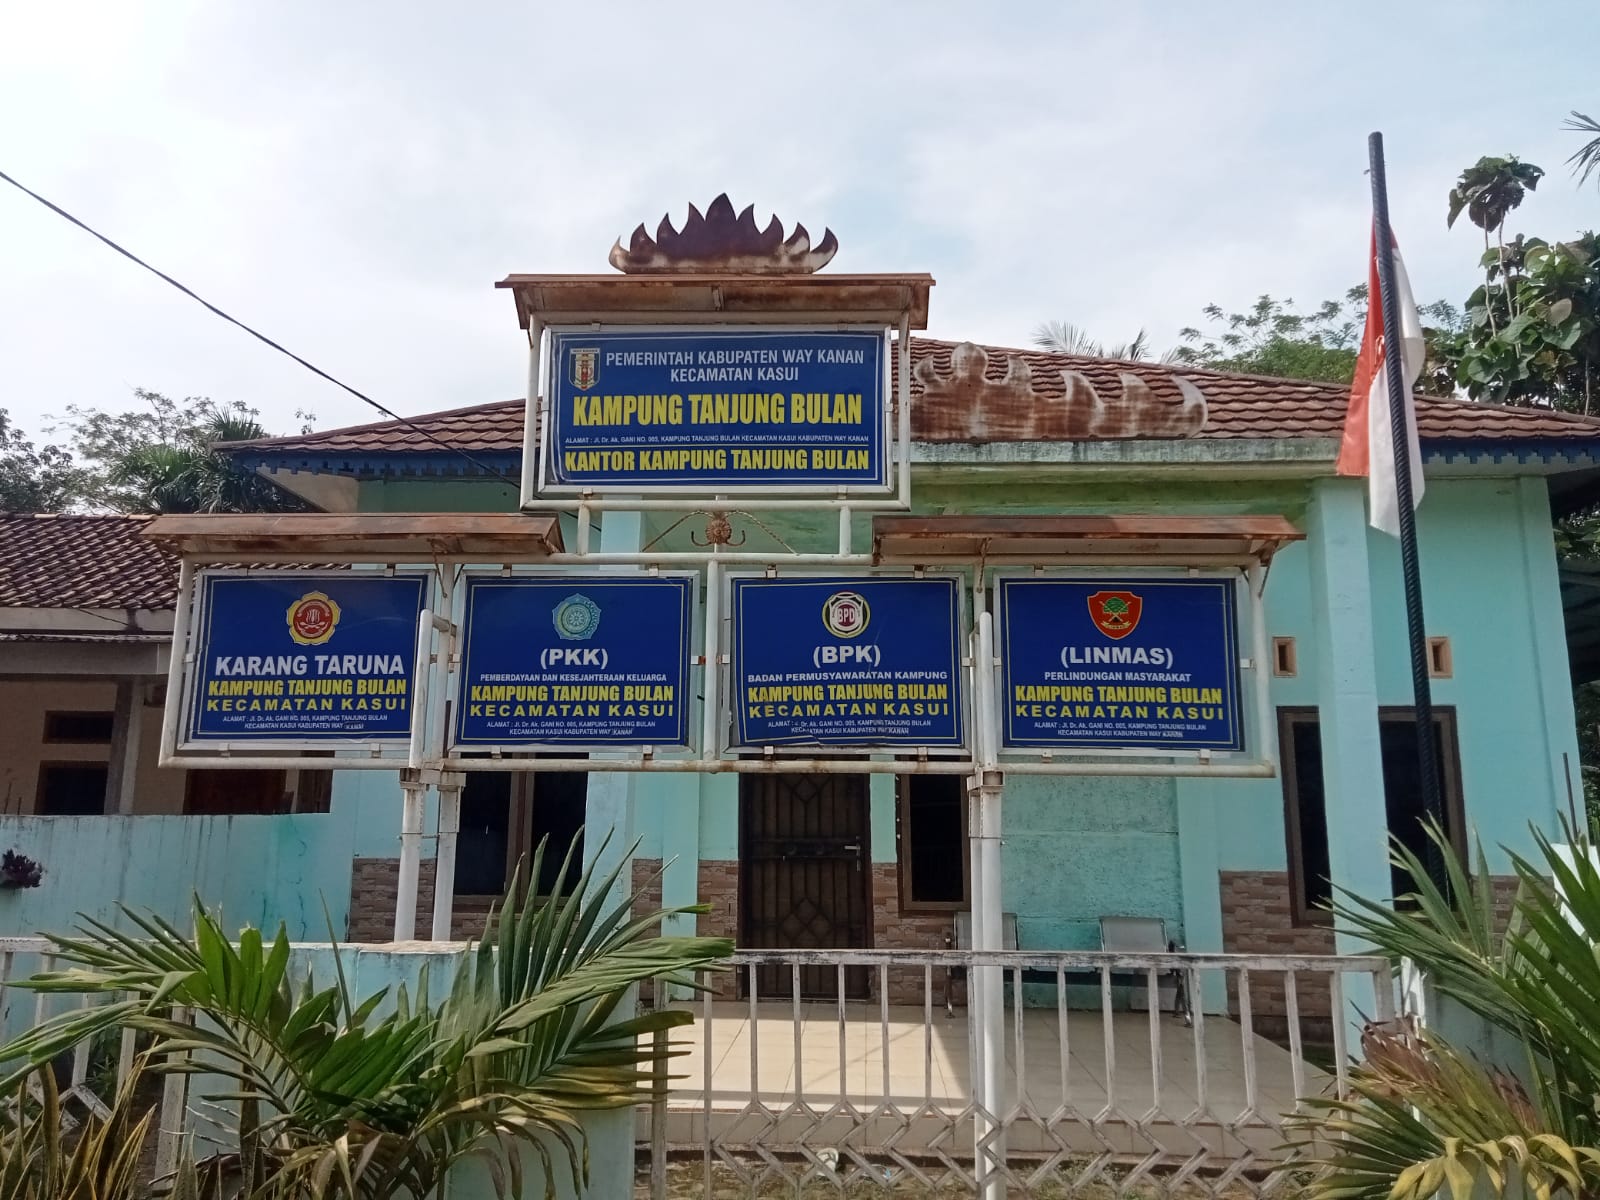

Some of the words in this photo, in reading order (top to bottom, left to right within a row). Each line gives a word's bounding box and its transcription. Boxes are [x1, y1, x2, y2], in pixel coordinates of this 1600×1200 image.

[605, 351, 694, 366] PEMERINTAH
[698, 350, 778, 365] KABUPATEN
[782, 349, 812, 364] WAY
[817, 349, 864, 364] KANAN
[670, 368, 752, 383] KECAMATAN
[757, 367, 799, 382] KASUI
[573, 394, 682, 426] KAMPUNG
[688, 393, 785, 425] TANJUNG
[791, 394, 862, 424] BULAN
[565, 451, 635, 472] KANTOR
[639, 449, 726, 470] KAMPUNG
[731, 449, 808, 470] TANJUNG
[812, 449, 869, 470] BULAN
[540, 648, 608, 670] (PKK)
[813, 645, 881, 668] (BPK)
[1060, 646, 1174, 670] (LINMAS)
[215, 656, 308, 676] KARANG
[314, 655, 404, 675] TARUNA
[480, 673, 541, 682] PEMBERDAYAAN
[542, 673, 558, 682] DAN
[559, 673, 625, 682] KESEJAHTERAAN
[626, 673, 667, 682] KELUARGA
[747, 674, 783, 683] BADAN
[786, 672, 892, 681] PERMUSYAWARATAN
[894, 671, 948, 680] KAMPUNG
[1044, 672, 1122, 681] PERLINDUNGAN
[1125, 672, 1191, 682] MASYARAKAT
[208, 680, 284, 696] KAMPUNG
[288, 680, 353, 695] TANJUNG
[356, 679, 406, 695] BULAN
[471, 685, 549, 702] KAMPUNG
[552, 685, 619, 702] TANJUNG
[624, 685, 673, 702] BULAN
[748, 686, 824, 703] KAMPUNG
[827, 684, 894, 701] TANJUNG
[897, 684, 947, 700] BULAN
[1015, 685, 1094, 702] KAMPUNG
[1097, 686, 1167, 703] TANJUNG
[1170, 688, 1222, 705] BULAN
[207, 698, 333, 712] KECAMATAN
[341, 698, 406, 711] KASUI
[470, 704, 600, 717] KECAMATAN
[608, 704, 673, 717] KASUI
[749, 703, 877, 719] KECAMATAN
[883, 703, 948, 716] KASUI
[1015, 705, 1148, 718] KECAMATAN
[1157, 706, 1224, 720] KASUI
[311, 714, 340, 722] KAMPUNG
[341, 714, 367, 722] TANJUNG
[368, 714, 388, 722] BULAN
[768, 720, 790, 728] ALAMAT
[884, 719, 910, 727] TANJUNG
[911, 719, 931, 727] BULAN
[1034, 721, 1057, 729] ALAMAT
[1088, 722, 1103, 730] GANI
